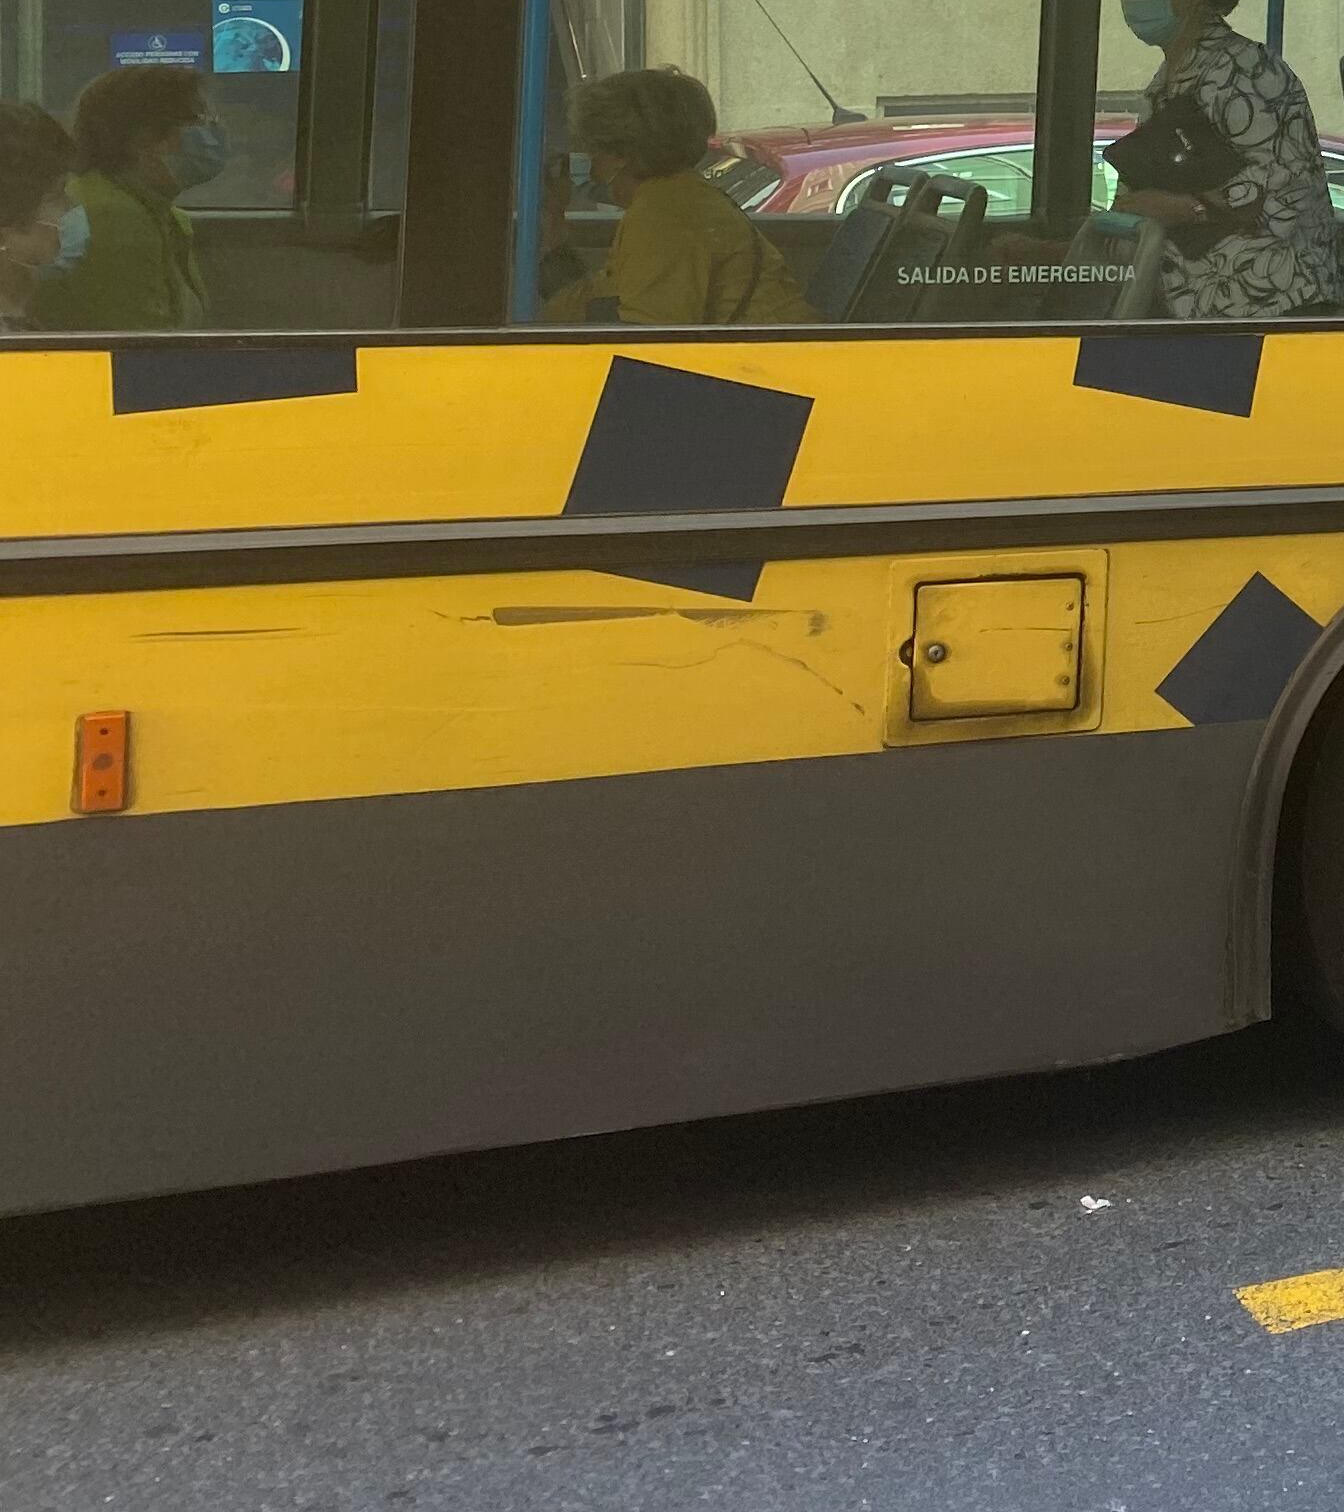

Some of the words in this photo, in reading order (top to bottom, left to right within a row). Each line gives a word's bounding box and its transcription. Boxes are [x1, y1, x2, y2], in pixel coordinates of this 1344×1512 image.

[897, 266, 970, 285] SALIDA
[973, 266, 1002, 285] DE
[1007, 264, 1137, 284] EMERGENCIA
